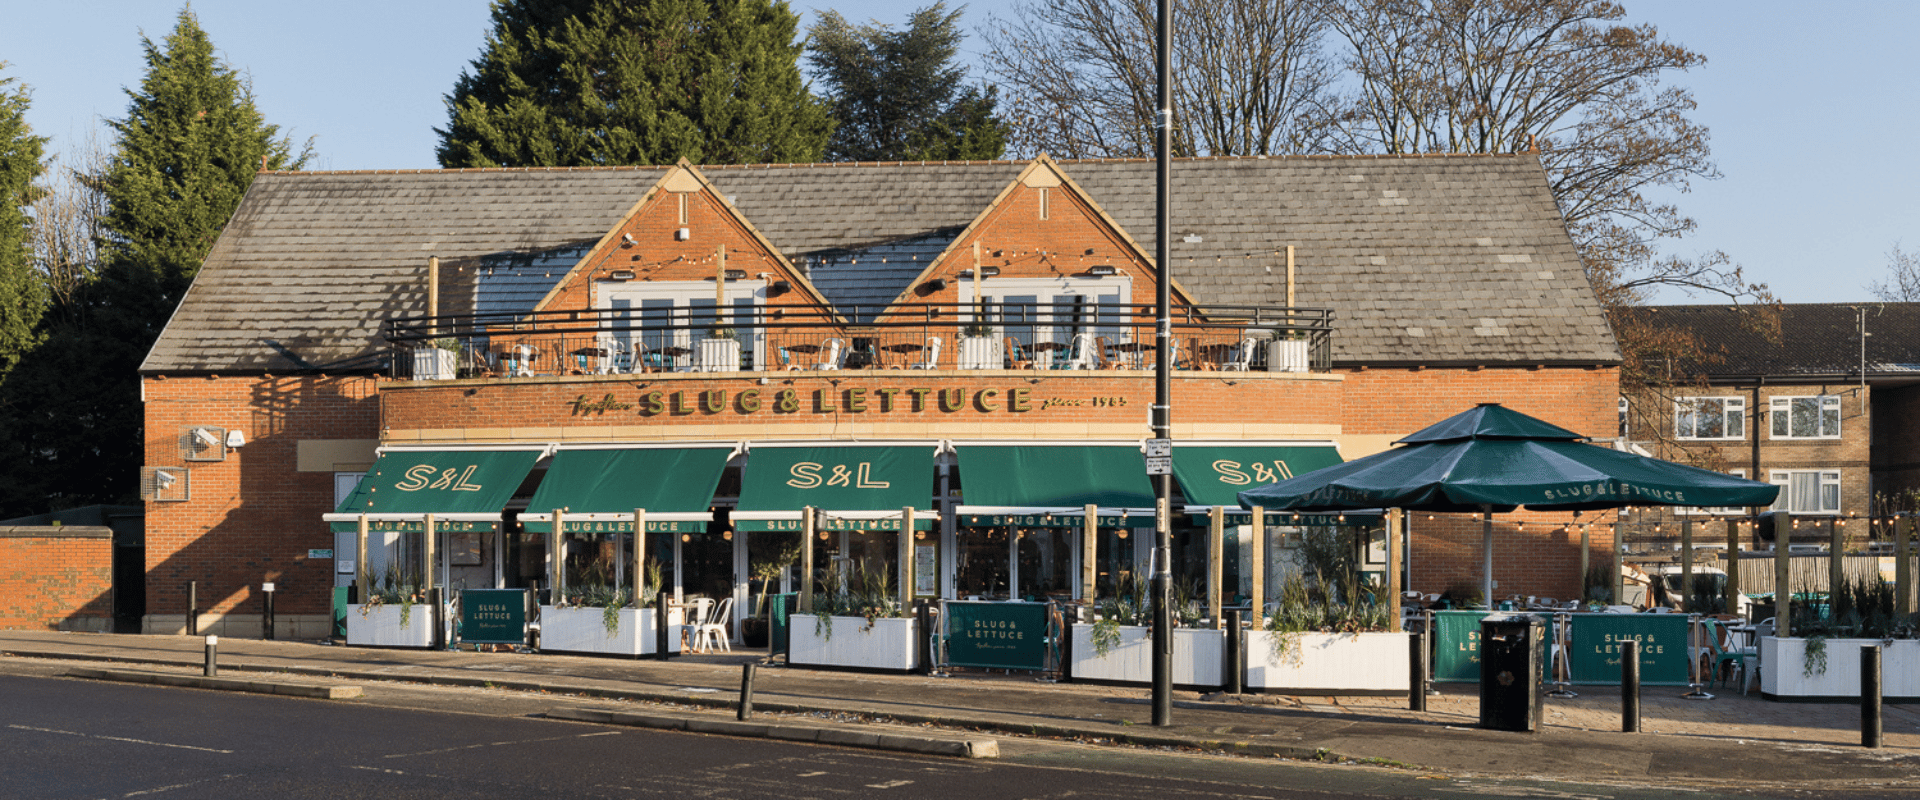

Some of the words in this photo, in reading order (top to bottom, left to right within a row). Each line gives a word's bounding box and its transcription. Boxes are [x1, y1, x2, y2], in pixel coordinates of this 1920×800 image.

[640, 389, 762, 417] SLUG
[774, 388, 800, 414] &
[814, 387, 1033, 414] LETTUCE
[1544, 484, 1592, 500] SLUG
[1609, 483, 1685, 501] LETTUCE
[993, 516, 1035, 525] SLUG
[1052, 517, 1127, 526] LETUCE
[1224, 515, 1251, 524] SLU
[367, 522, 394, 531] LUG
[407, 522, 470, 531] LETUCE
[562, 522, 591, 531] LUG
[608, 522, 678, 531] LETUCE
[767, 520, 803, 530] SLU
[827, 520, 901, 530] LETTUCE
[474, 612, 511, 620] LETTUCE
[974, 620, 1006, 629] SLUG
[1009, 621, 1016, 629] &
[967, 630, 1024, 640] LETTUCE
[1595, 645, 1664, 654] LETCE
